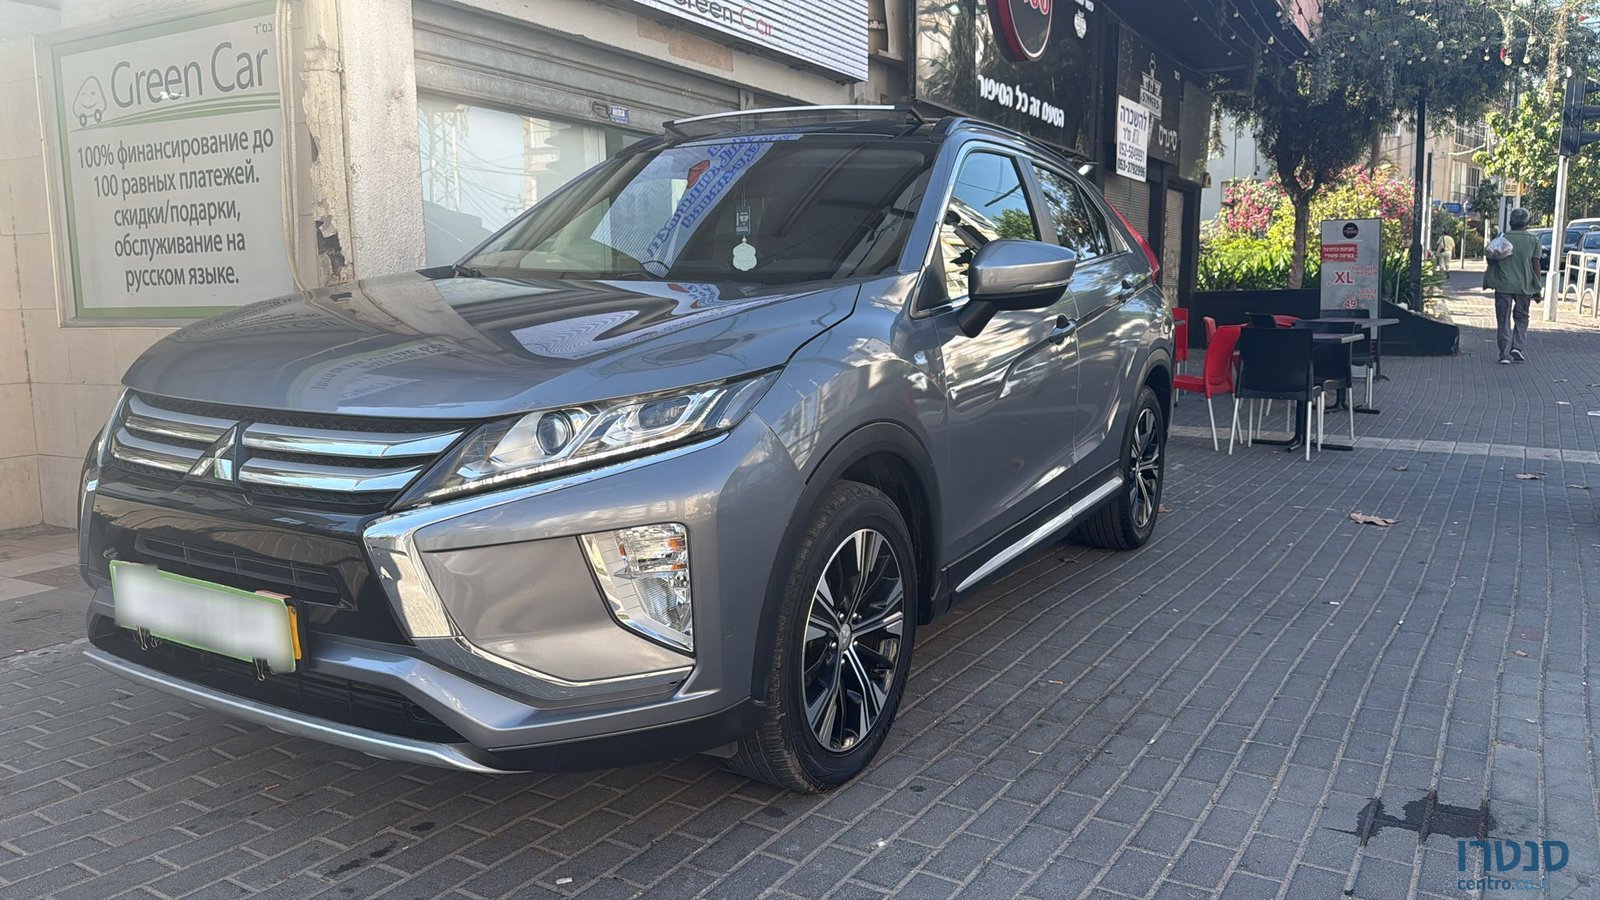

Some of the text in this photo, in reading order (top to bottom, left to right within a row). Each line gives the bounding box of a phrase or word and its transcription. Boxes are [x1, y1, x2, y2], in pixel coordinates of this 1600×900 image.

[673, 0, 773, 37] reen Car
[110, 41, 269, 109] Green Car
[977, 74, 1014, 108] הסיפור
[1015, 84, 1029, 113] כל
[1029, 96, 1041, 118] זה
[1120, 105, 1147, 131] להשכרה
[77, 126, 275, 169] 100% финансирование до
[94, 161, 260, 199] 100 равных платежей.
[114, 199, 242, 231] скидки/подарки,
[114, 231, 246, 262] обслуживание на
[125, 264, 240, 293] русском языке.
[1334, 271, 1354, 284] XL
